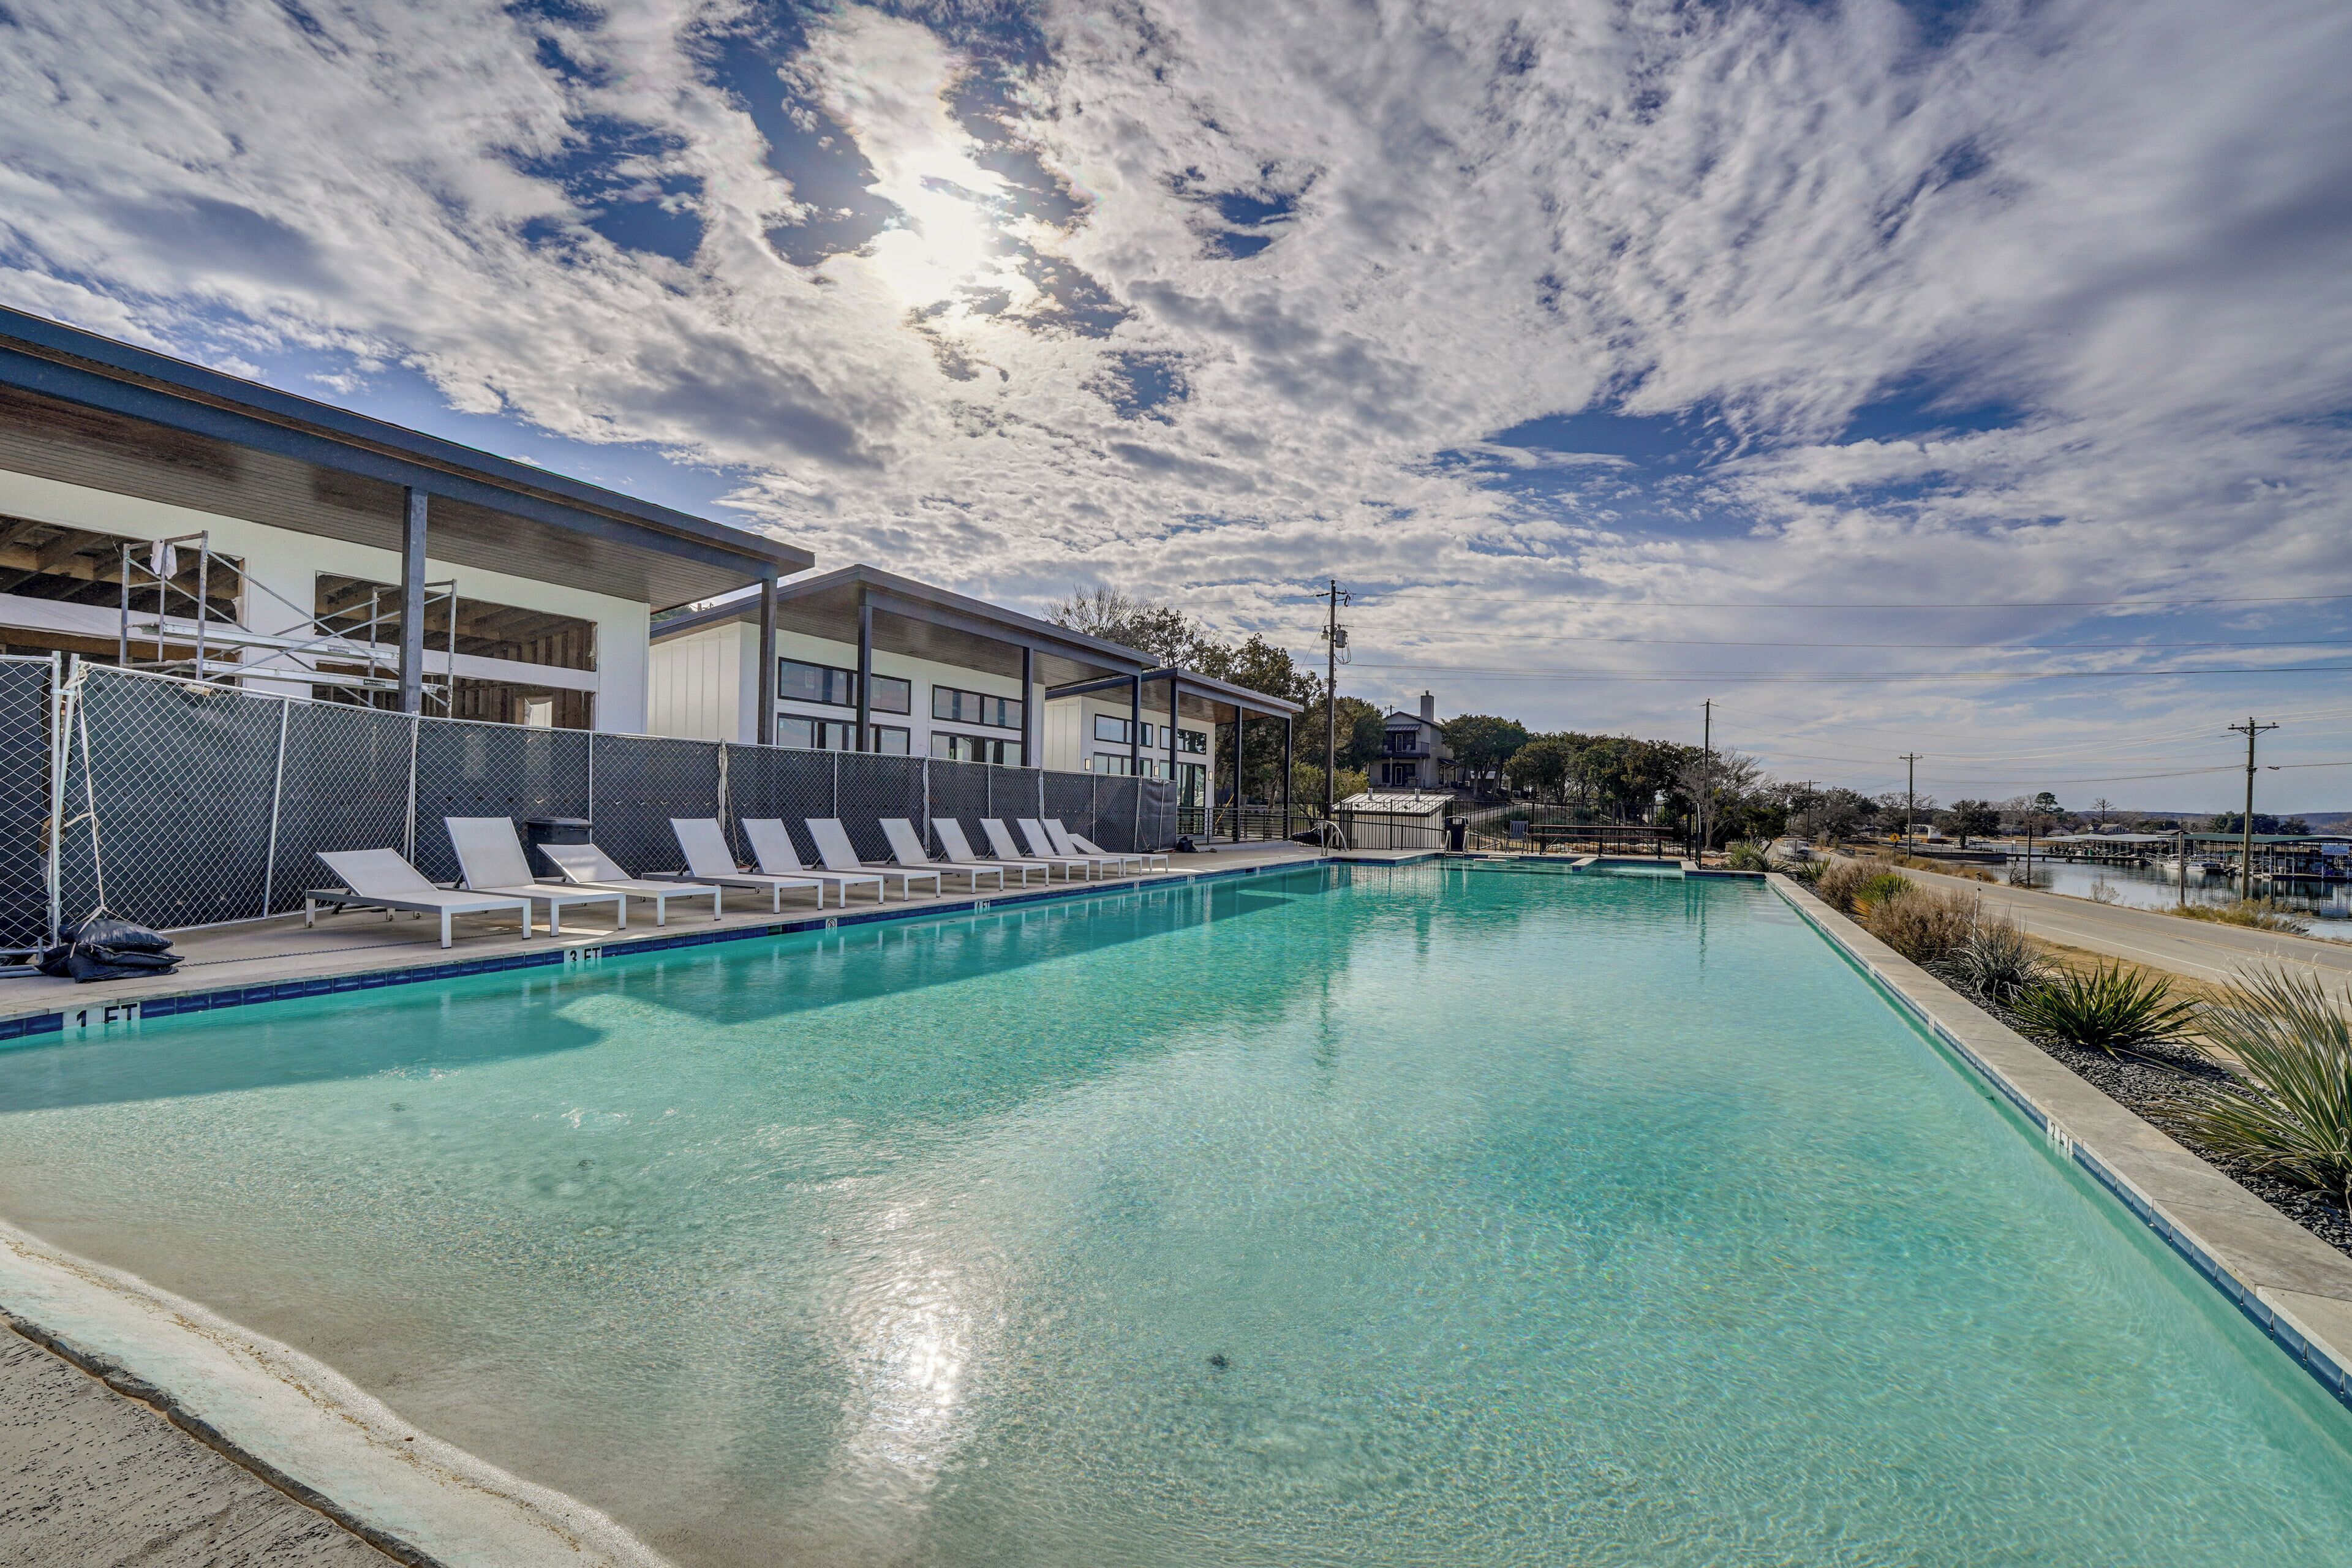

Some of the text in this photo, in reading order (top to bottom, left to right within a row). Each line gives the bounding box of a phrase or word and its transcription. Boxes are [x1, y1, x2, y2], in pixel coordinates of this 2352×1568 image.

[584, 947, 600, 960] FT
[77, 1003, 138, 1027] 1 FT
